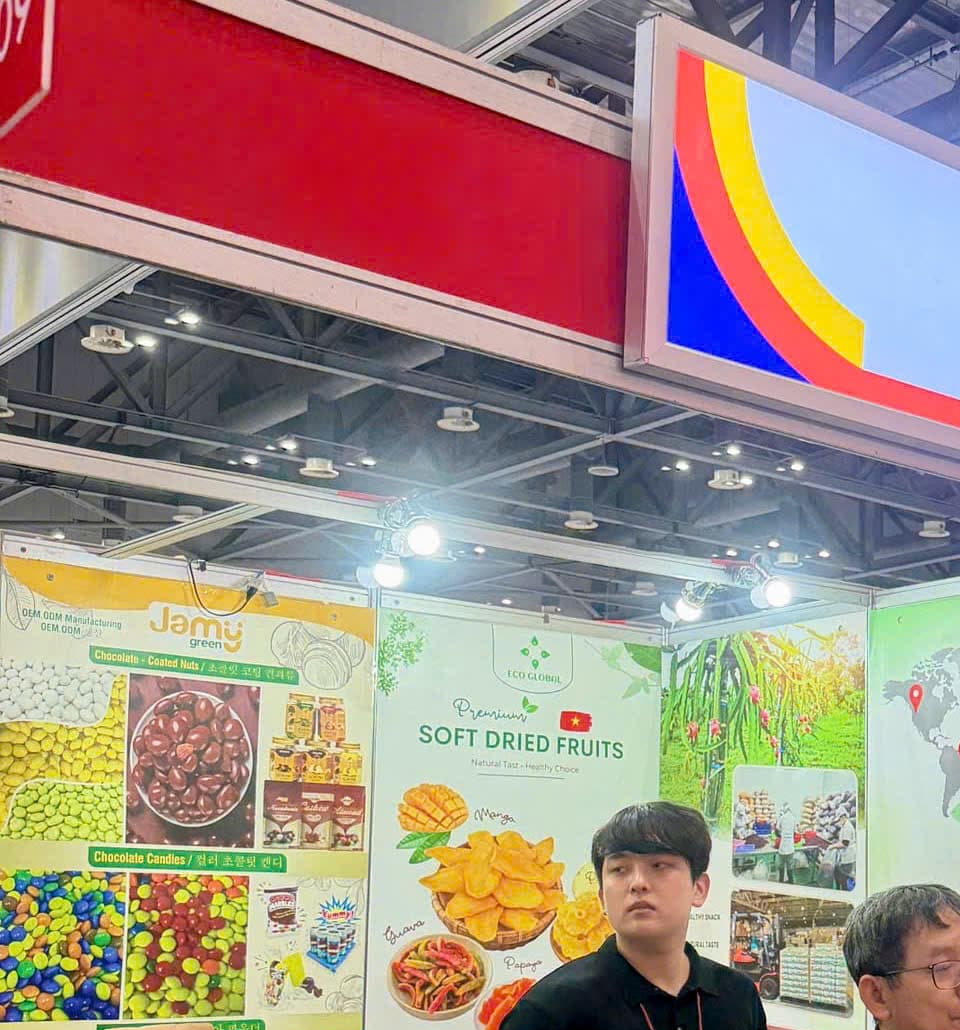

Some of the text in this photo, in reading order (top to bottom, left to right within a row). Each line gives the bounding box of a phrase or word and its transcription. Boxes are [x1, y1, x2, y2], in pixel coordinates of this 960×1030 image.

[150, 606, 243, 654] Jamy
[190, 637, 222, 650] green
[94, 650, 138, 665] Chocolate
[148, 656, 178, 669] Coated
[180, 659, 199, 671] Nuts
[507, 669, 526, 679] ECO
[452, 697, 527, 722] Premium
[418, 725, 624, 759] SOFT DRIED FRUITS
[471, 758, 501, 768] Natural
[554, 764, 580, 774] Choice
[94, 852, 144, 865] Chocolate
[146, 853, 186, 866] Candies
